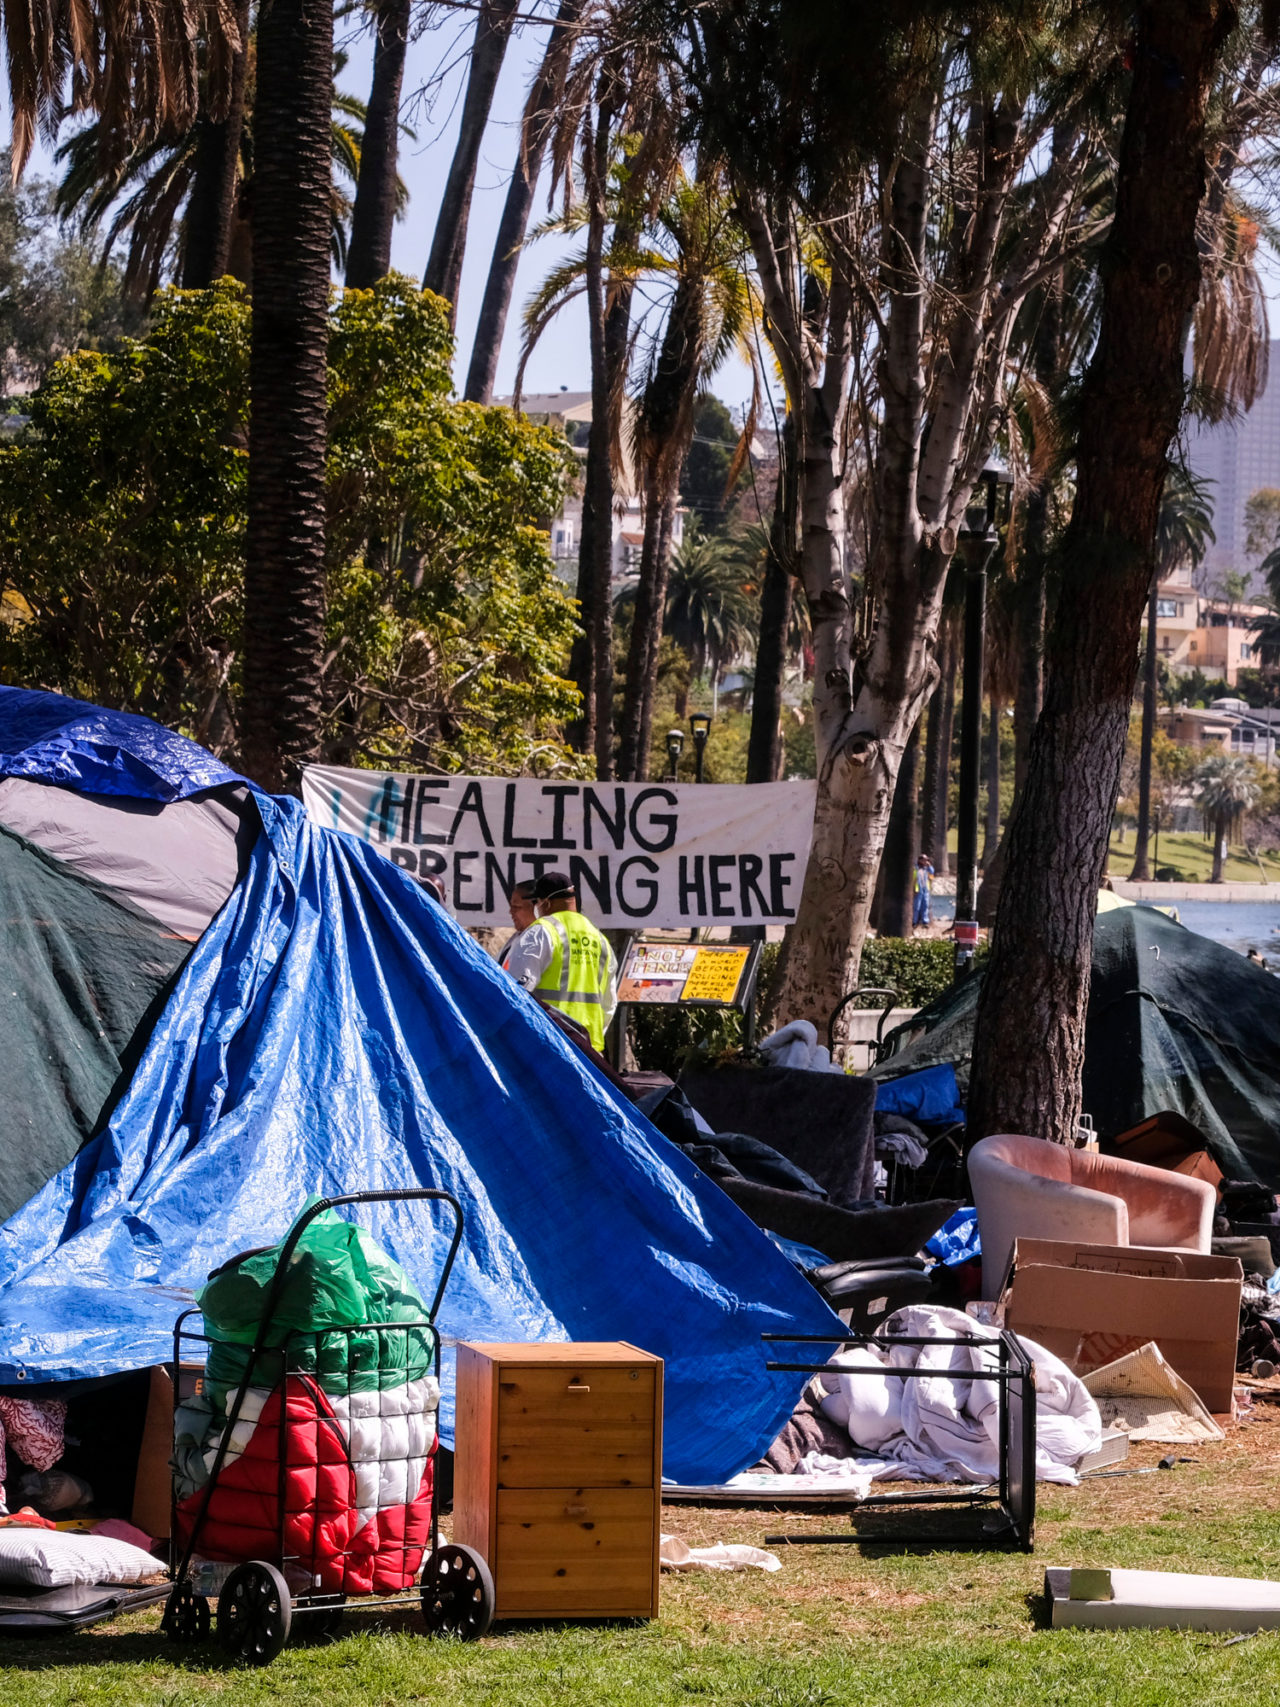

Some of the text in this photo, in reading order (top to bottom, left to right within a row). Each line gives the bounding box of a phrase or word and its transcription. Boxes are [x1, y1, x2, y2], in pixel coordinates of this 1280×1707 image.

[378, 777, 678, 853] HEALING
[679, 853, 796, 917] HERE
[690, 972, 736, 980] POLICING
[687, 991, 724, 999] AFTER
